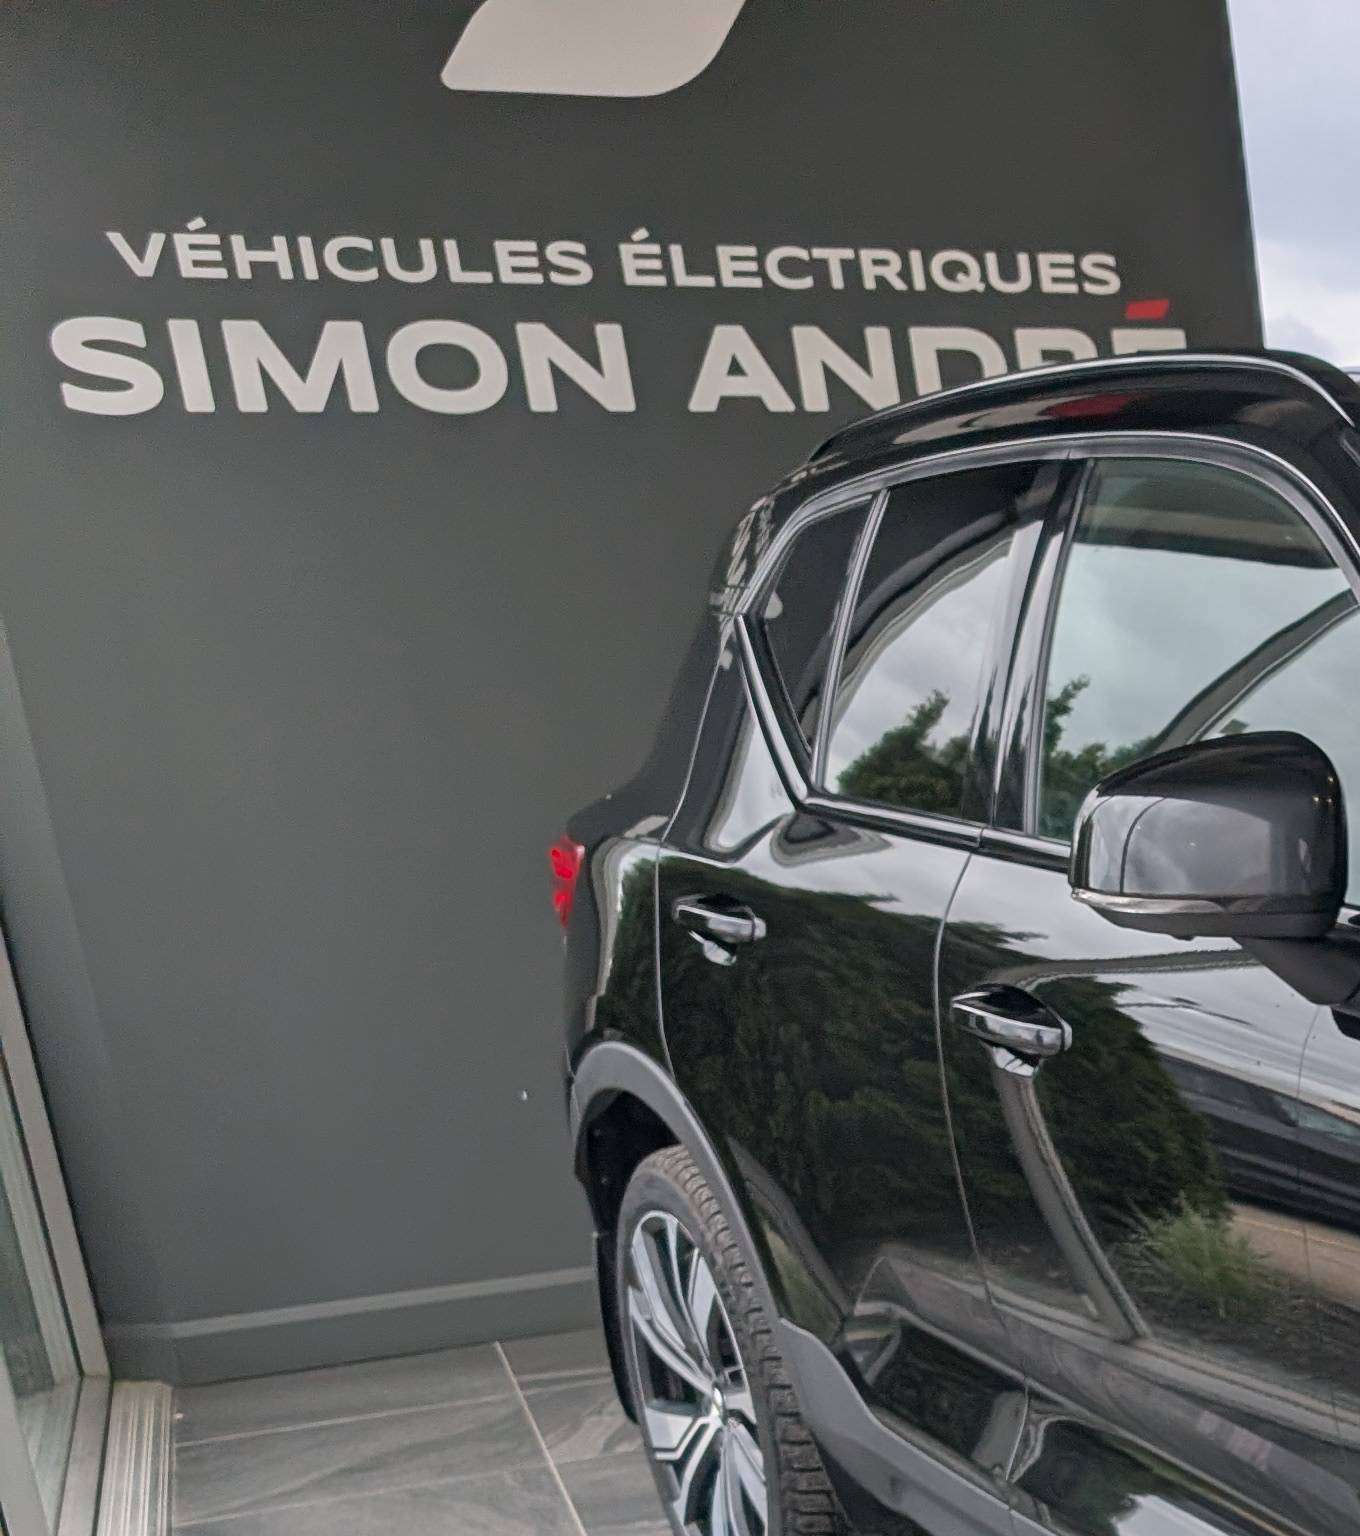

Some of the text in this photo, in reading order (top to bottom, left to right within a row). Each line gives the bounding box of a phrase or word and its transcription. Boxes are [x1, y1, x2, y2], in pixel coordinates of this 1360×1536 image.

[106, 217, 1122, 296] VÉHICULES ÉLECTRIQUES
[50, 315, 637, 416] SIMON
